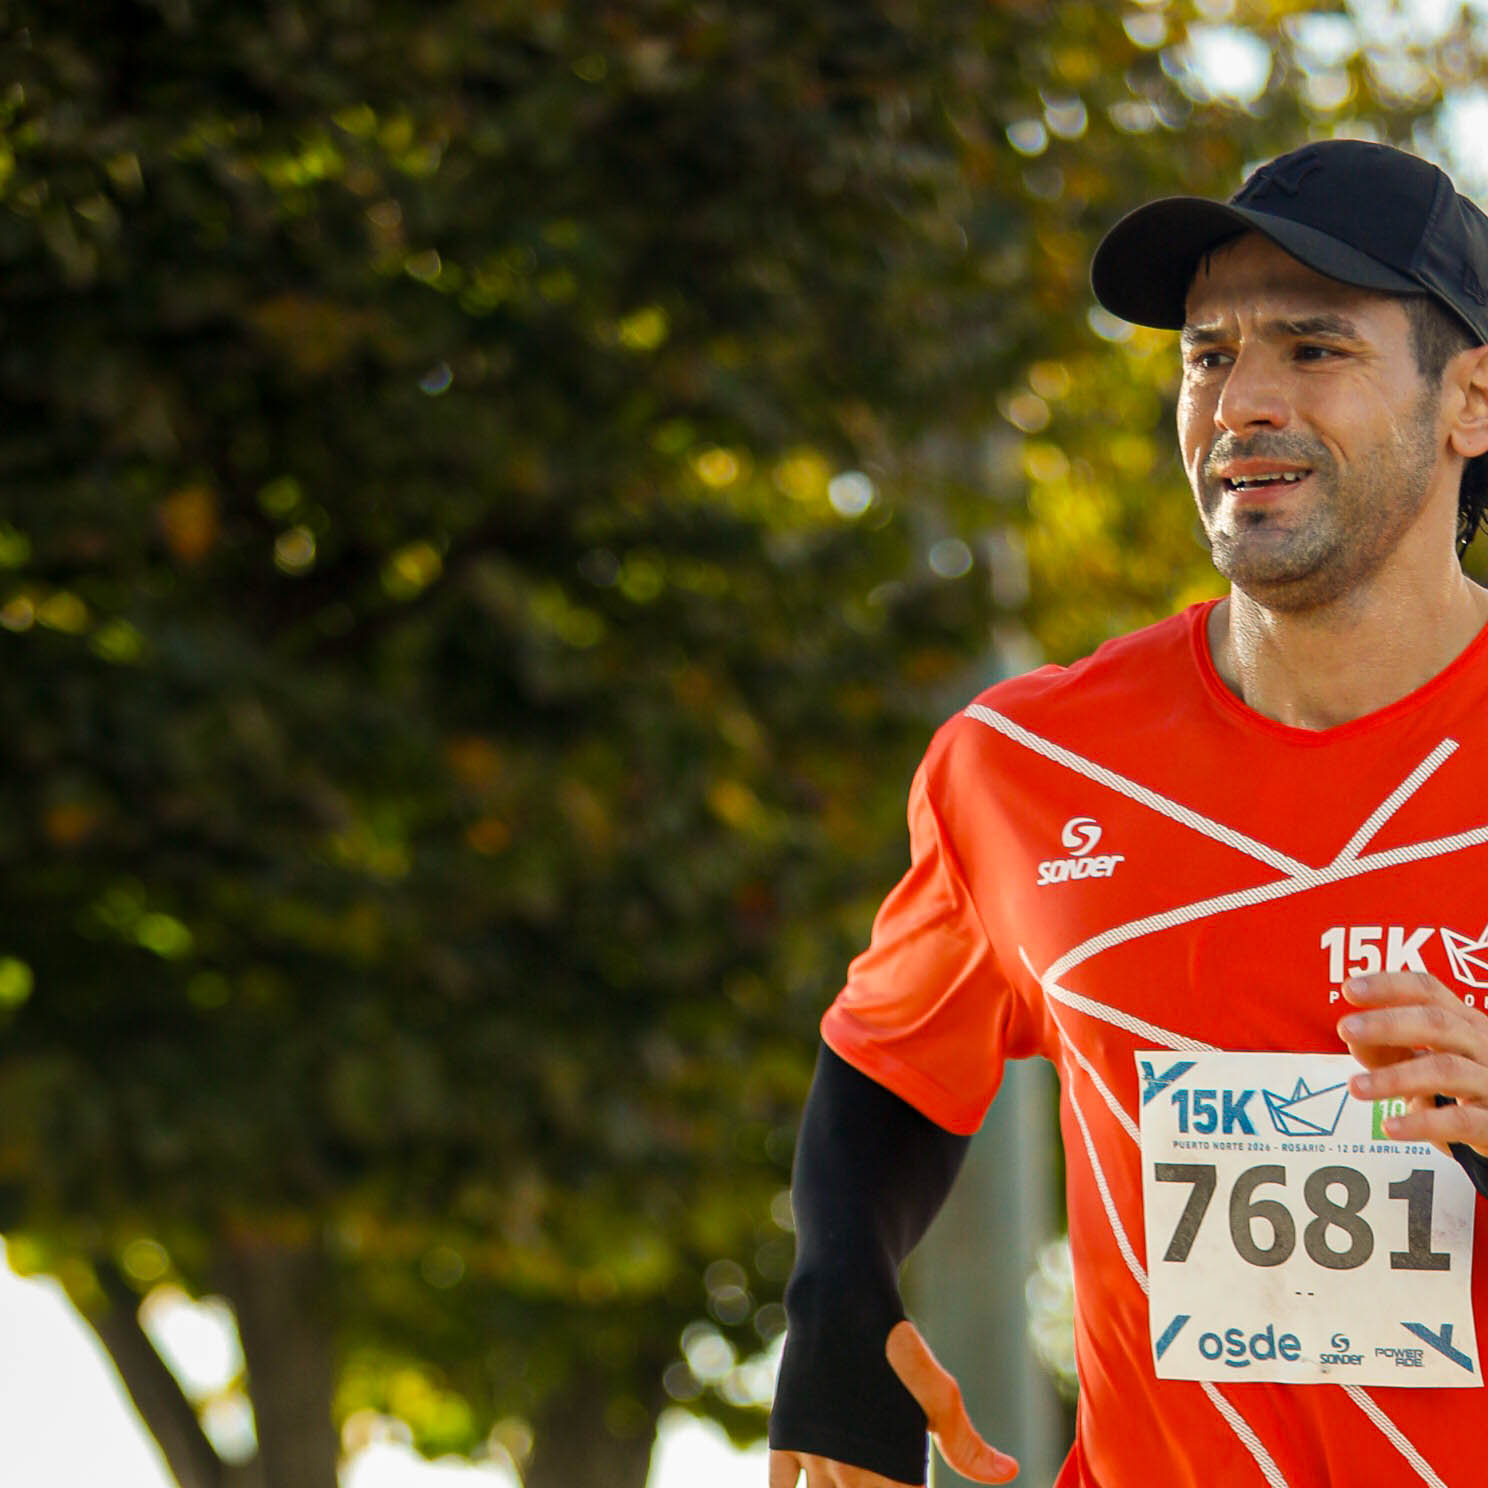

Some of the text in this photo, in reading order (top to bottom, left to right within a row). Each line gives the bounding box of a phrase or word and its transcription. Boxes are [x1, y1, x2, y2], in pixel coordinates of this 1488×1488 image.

[1320, 926, 1435, 983] 15K
[1171, 1089, 1257, 1136] 15K
[1172, 1140, 1210, 1150] PUERTO
[1213, 1141, 1244, 1151] NORTE
[1247, 1142, 1271, 1152] 2026
[1281, 1143, 1326, 1153] ROSARIO
[1337, 1143, 1349, 1153] 12
[1352, 1144, 1365, 1154] DE
[1368, 1144, 1401, 1154] ABRIL
[1404, 1145, 1432, 1155] 2026
[1154, 1163, 1451, 1271] 7681
[1198, 1323, 1302, 1361] osde
[1375, 1347, 1424, 1359] POWER
